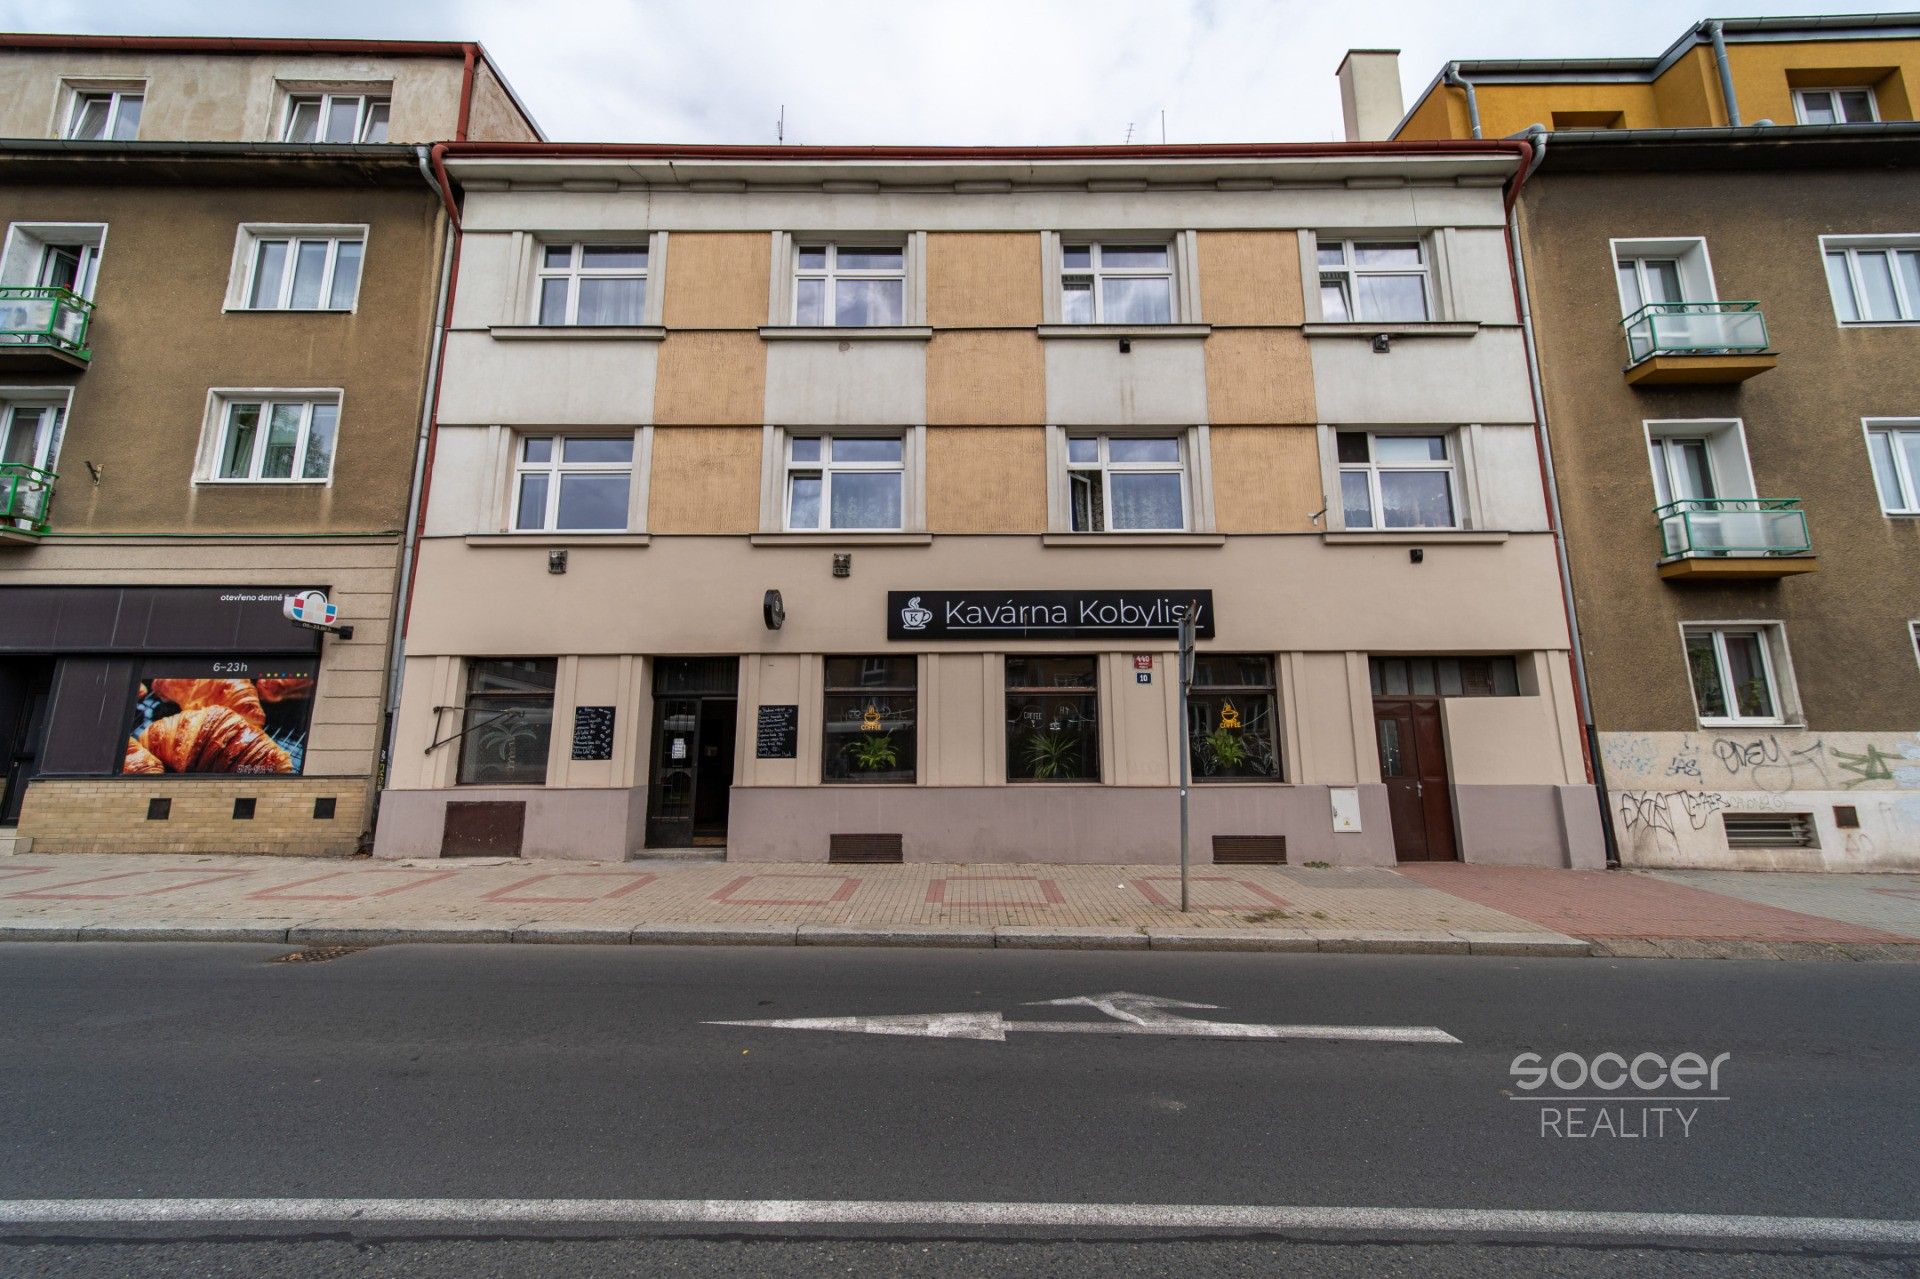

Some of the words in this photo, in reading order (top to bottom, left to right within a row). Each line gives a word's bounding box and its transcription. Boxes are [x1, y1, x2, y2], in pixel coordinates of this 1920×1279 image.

[220, 593, 257, 601] otevřeno
[258, 593, 283, 601] denně
[946, 599, 1067, 624] Kavárna
[910, 613, 917, 622] K
[1139, 674, 1148, 682] 10
